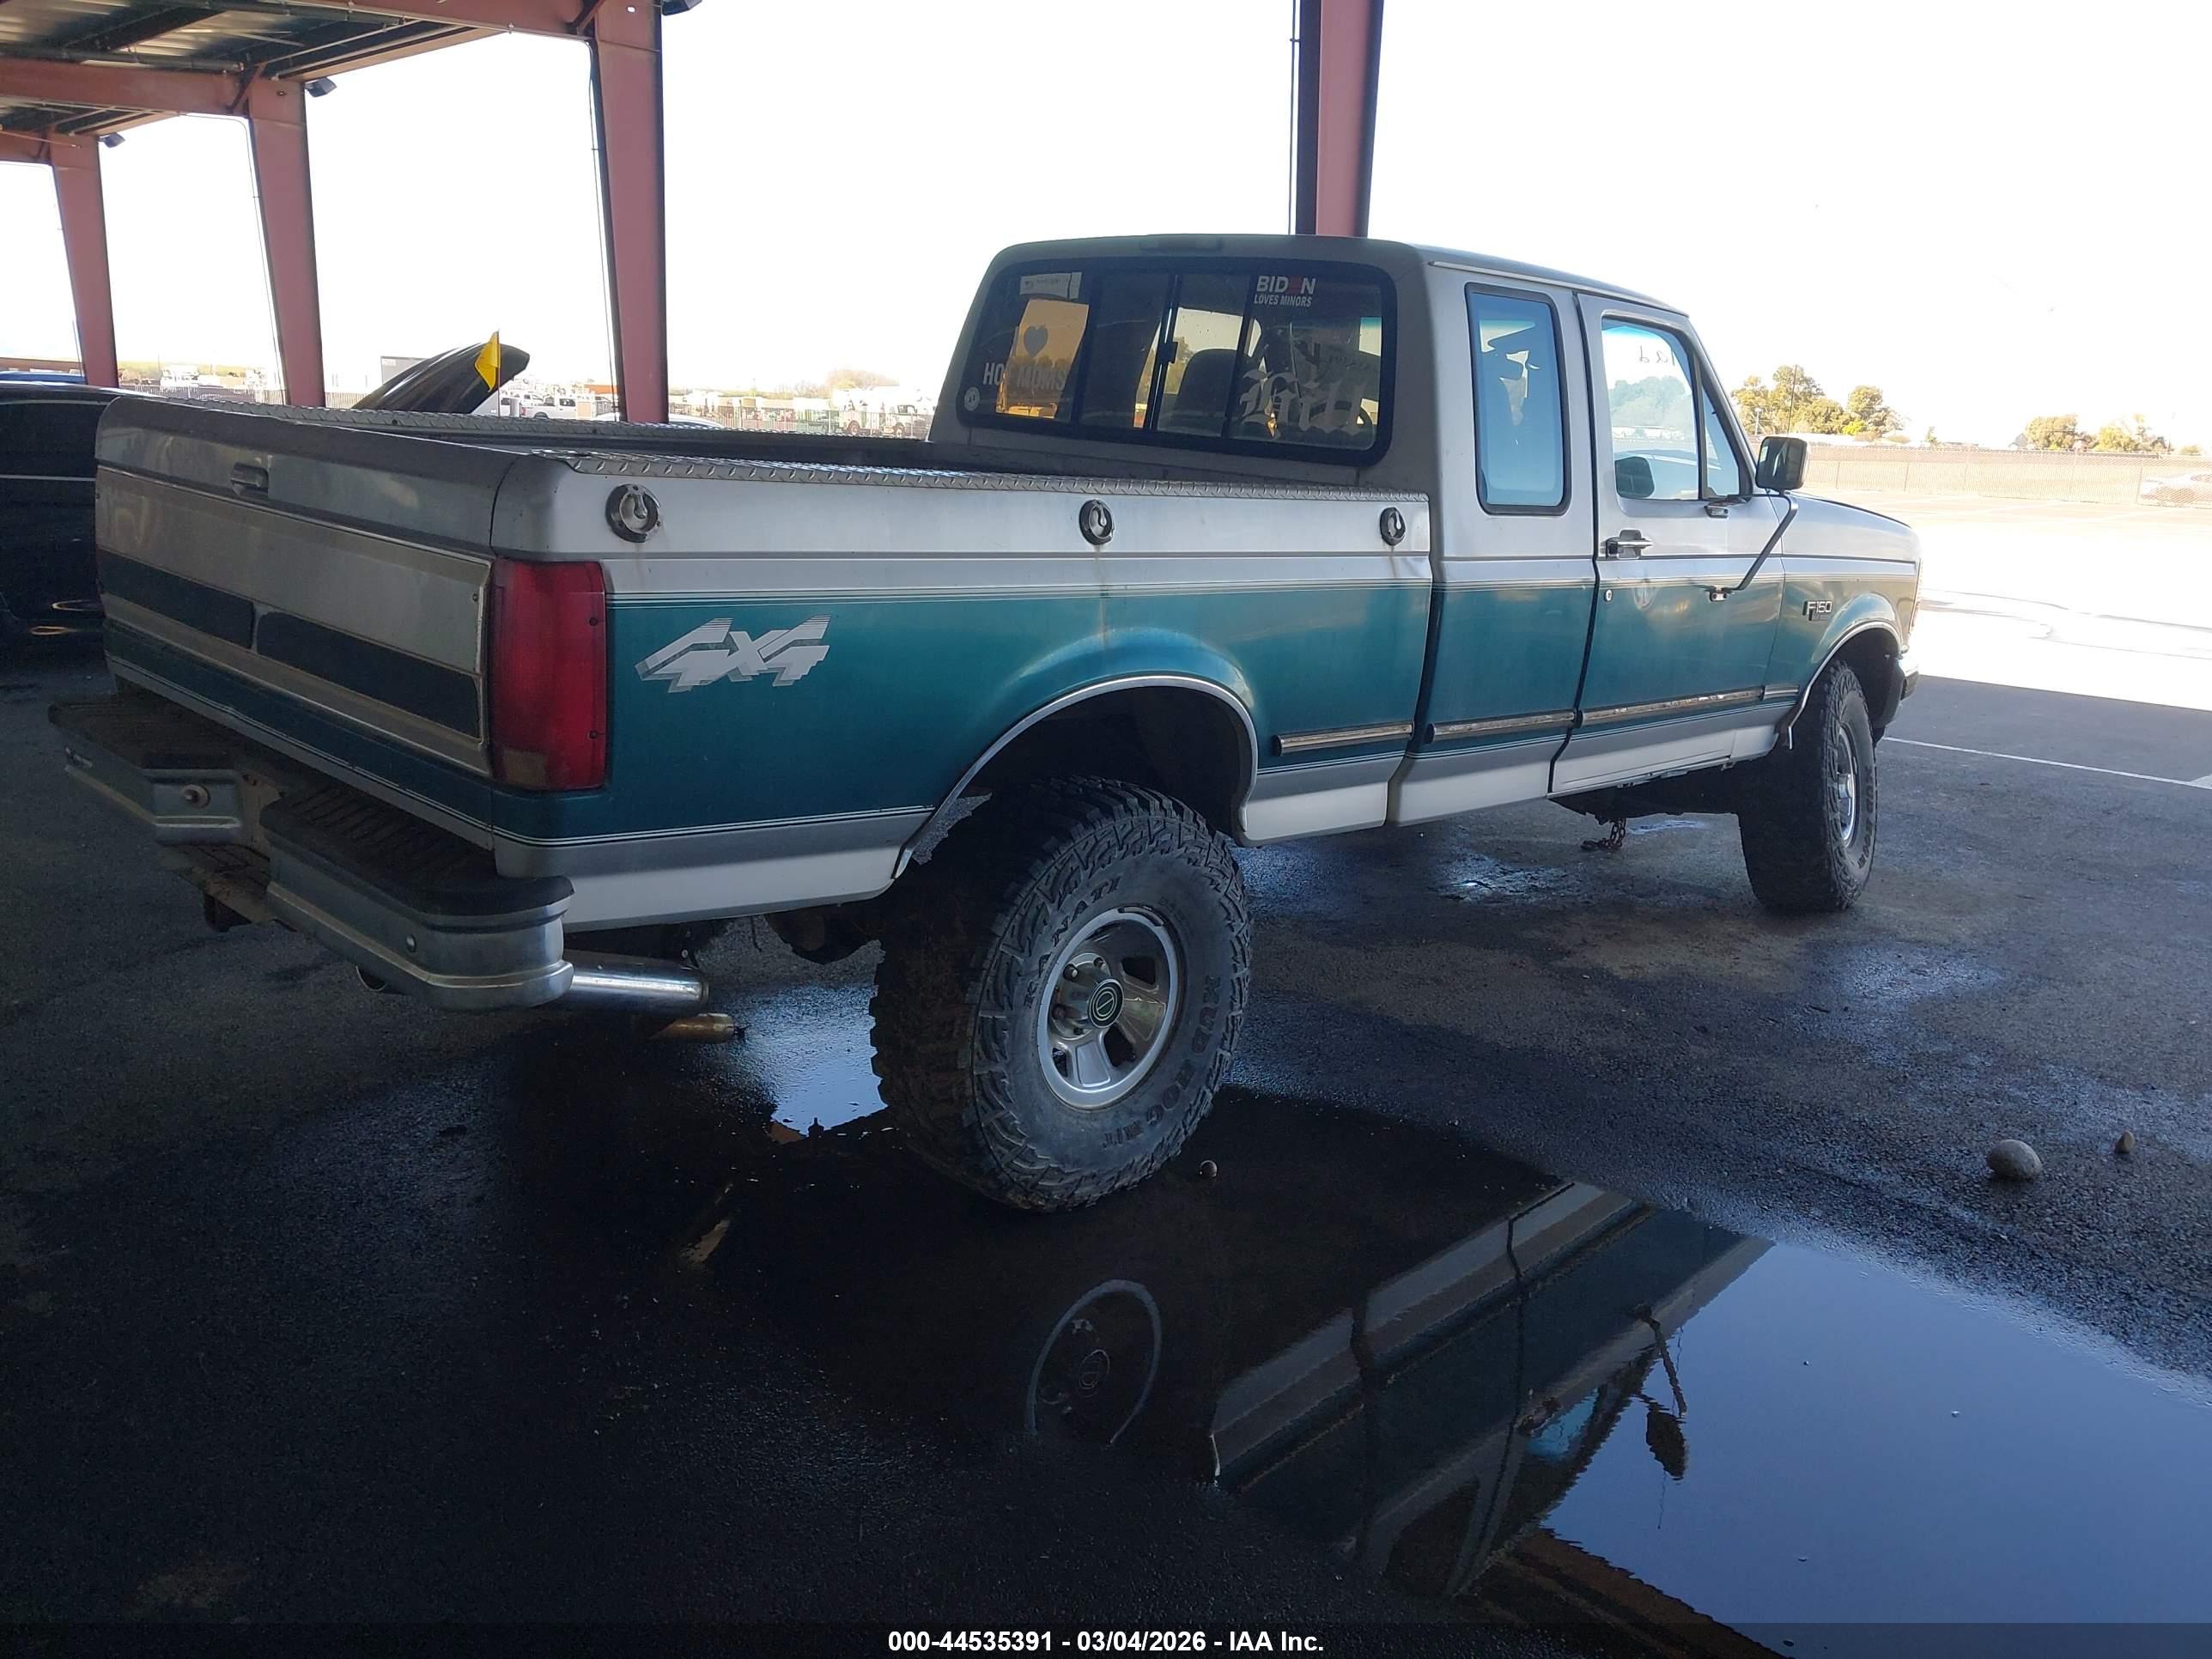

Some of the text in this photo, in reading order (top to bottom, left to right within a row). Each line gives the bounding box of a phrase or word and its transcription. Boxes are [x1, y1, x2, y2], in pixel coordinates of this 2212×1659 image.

[1256, 275, 1316, 295] BIDN
[1253, 293, 1313, 307] LOVES MINORS
[1016, 365, 1067, 391] MOMS
[1804, 600, 1832, 617] F150
[1023, 876, 1121, 1009] KANATI
[1191, 974, 1221, 1054] MUD
